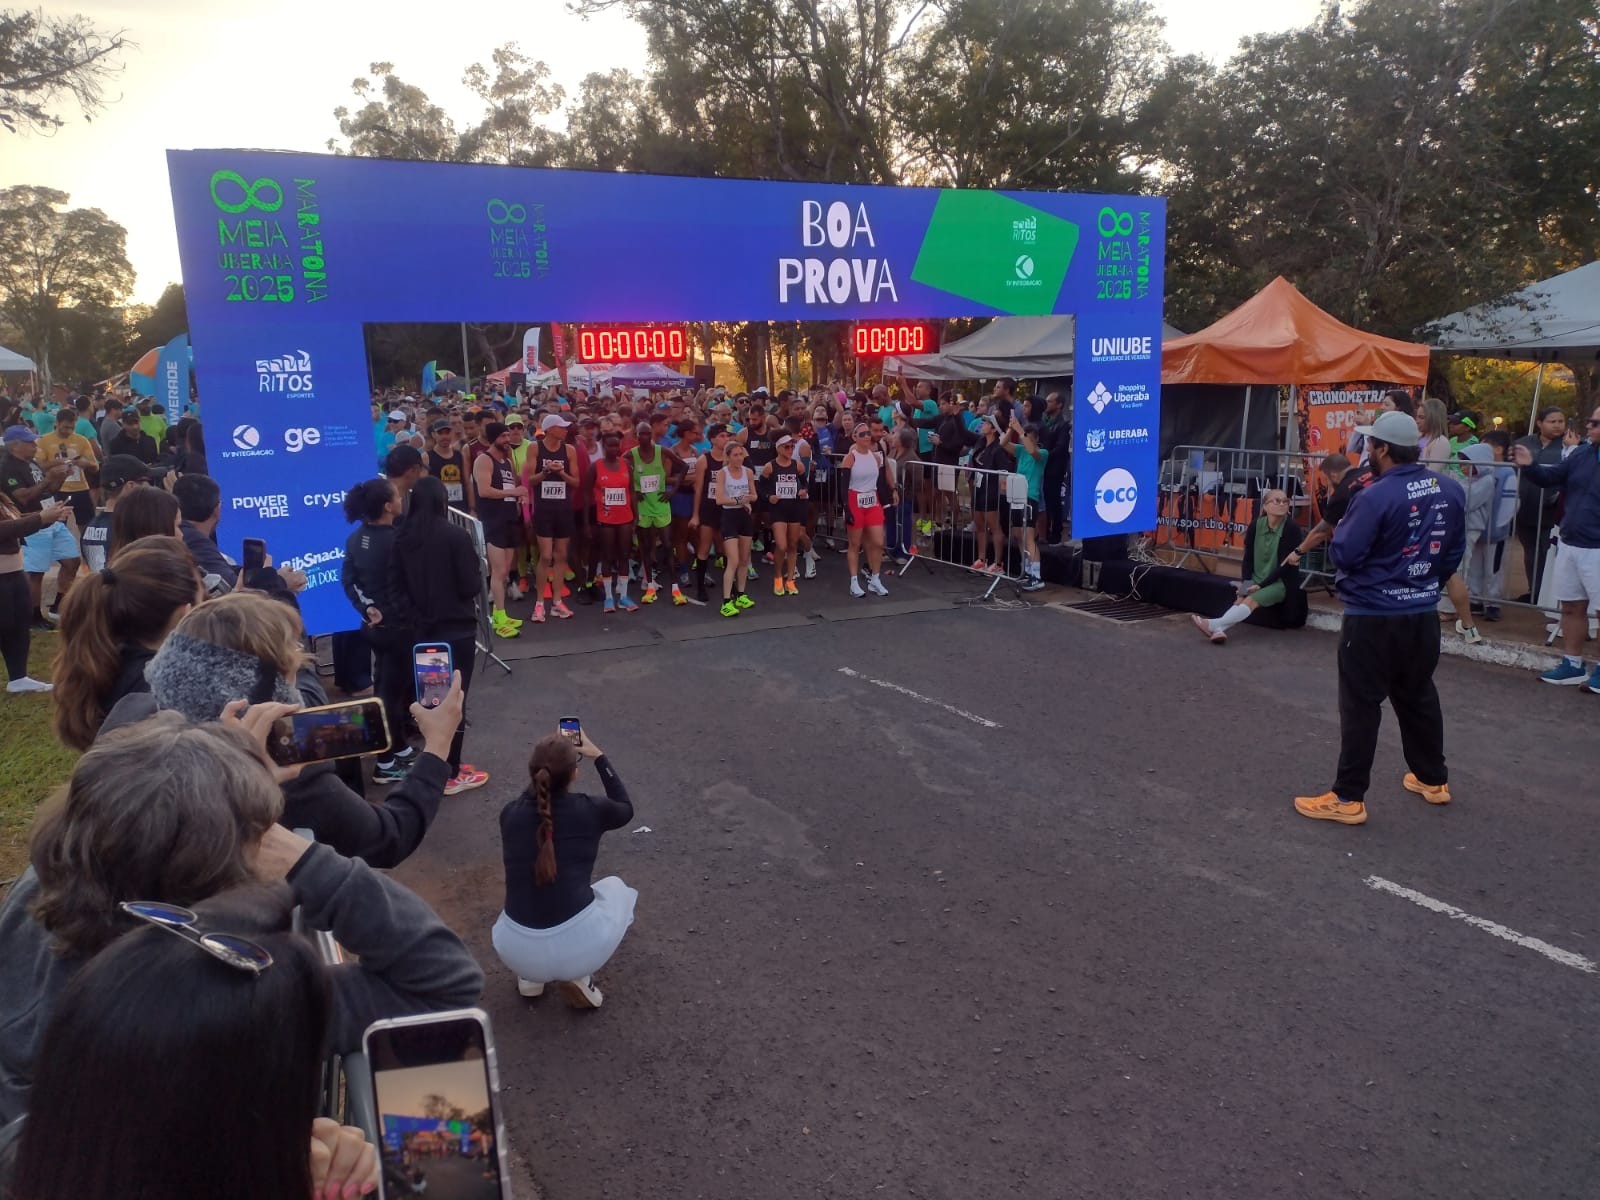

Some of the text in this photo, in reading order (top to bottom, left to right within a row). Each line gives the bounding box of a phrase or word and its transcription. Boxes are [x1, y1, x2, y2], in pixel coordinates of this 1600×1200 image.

[218, 218, 289, 248] MEIA
[802, 200, 876, 248] BOA
[294, 178, 328, 303] MARATONA
[490, 227, 529, 247] MEIA
[1099, 241, 1132, 261] MEIA
[1137, 211, 1151, 299] MARATONA
[493, 261, 530, 278] 2025
[224, 274, 295, 303] 2025
[779, 258, 899, 304] PROVA
[1097, 280, 1132, 299] 2025
[581, 330, 683, 360] 00:00:00
[1091, 336, 1152, 356] UNIUBE
[259, 373, 313, 393] RITOS
[1118, 384, 1146, 392] Shopping
[1113, 391, 1150, 402] Uberaba
[1309, 390, 1386, 405] CRONOMETRA
[284, 427, 321, 453] ge
[1108, 428, 1149, 439] UBERABA
[232, 494, 288, 510] POWER
[303, 490, 349, 508] cryst
[1094, 486, 1138, 506] FOCO
[259, 505, 289, 519] ADE
[318, 569, 340, 586] DOCE
